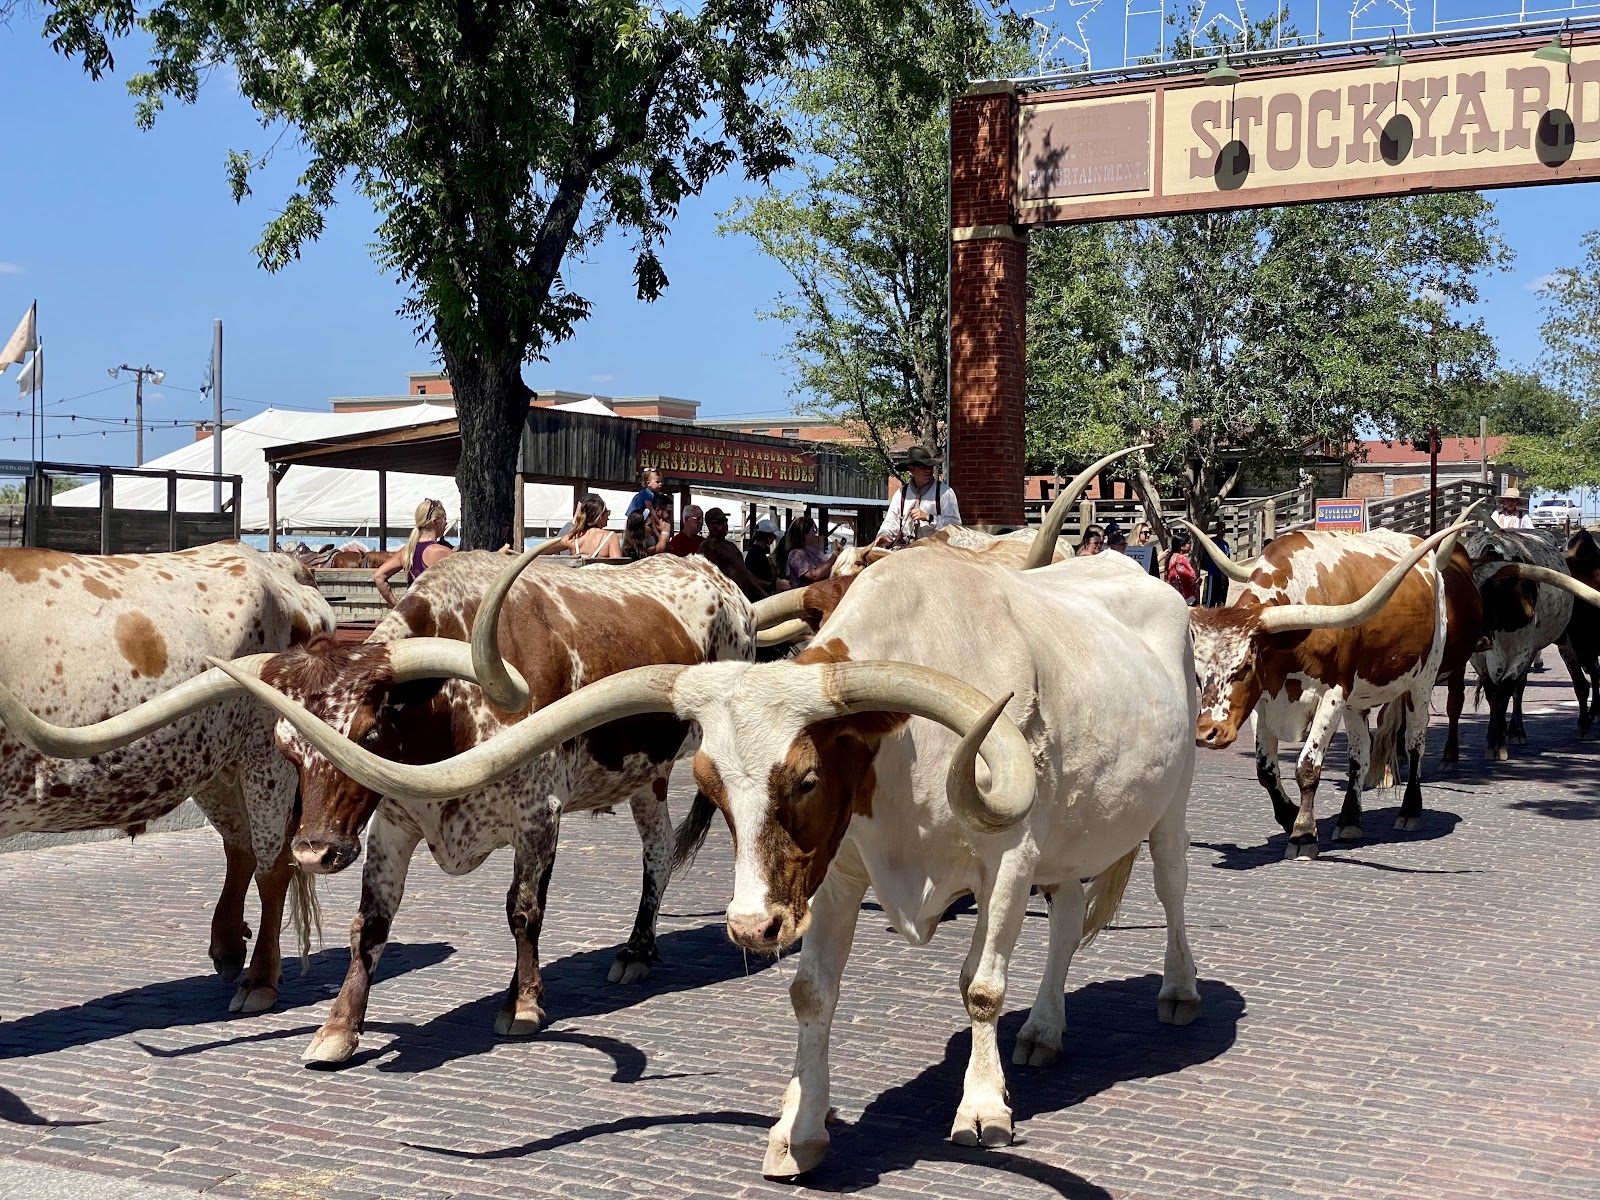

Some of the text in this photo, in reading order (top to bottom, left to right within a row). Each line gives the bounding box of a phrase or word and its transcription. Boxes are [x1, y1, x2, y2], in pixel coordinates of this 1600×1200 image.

[1190, 60, 1600, 180] STOCKYARD
[640, 449, 815, 483] HORSEBACK TRAIL RIDES
[675, 441, 788, 463] STOCKYARD STABLES
